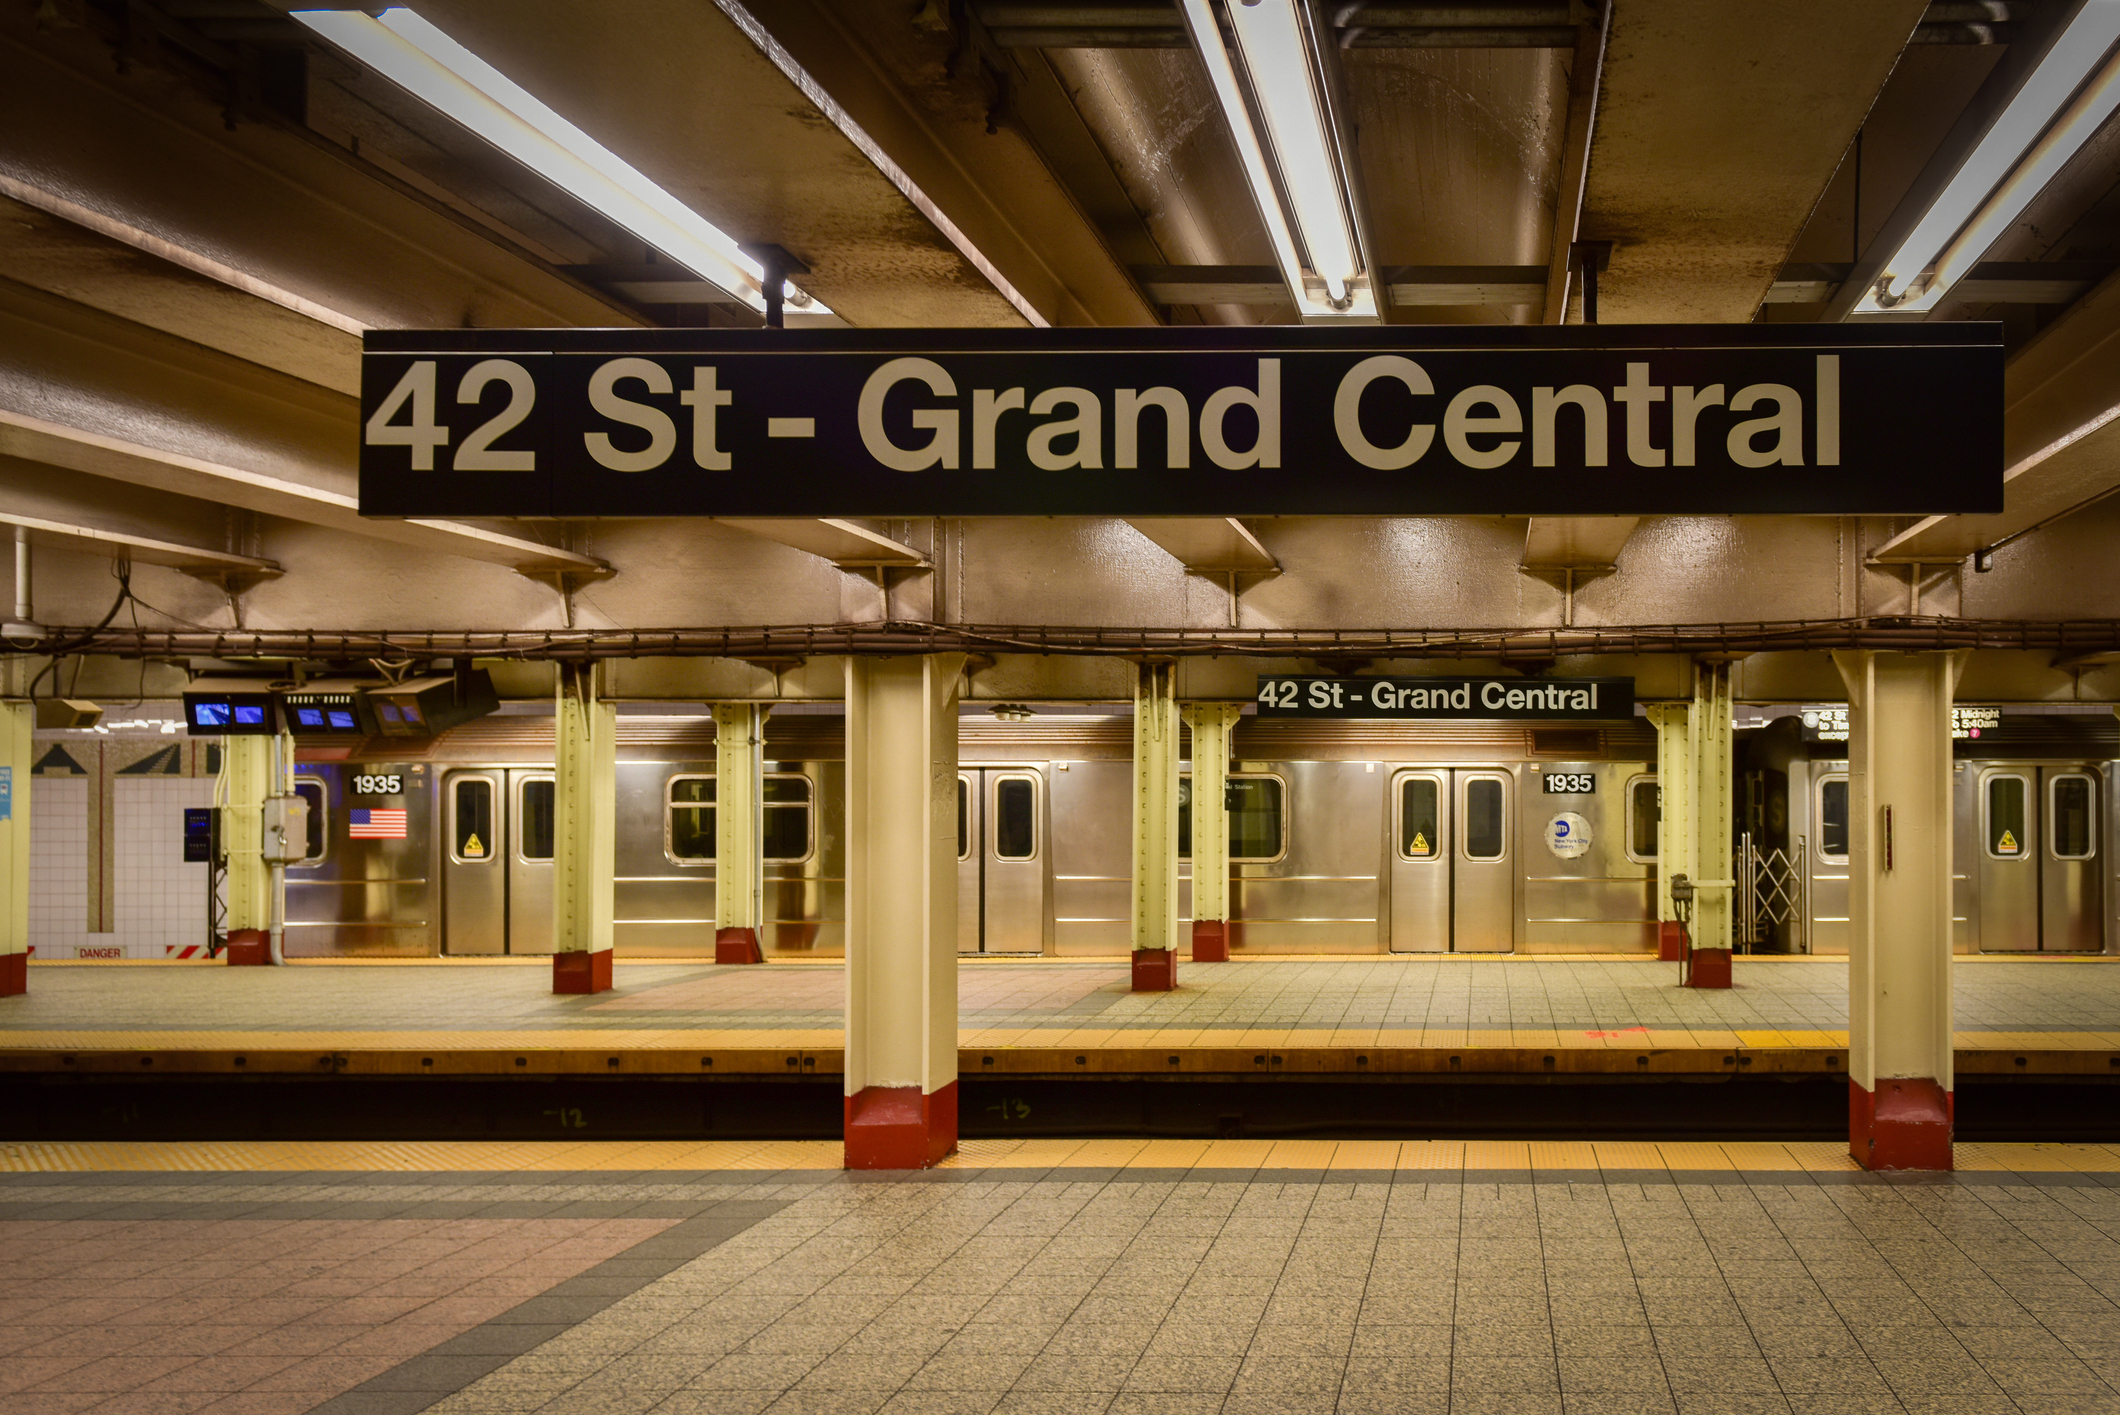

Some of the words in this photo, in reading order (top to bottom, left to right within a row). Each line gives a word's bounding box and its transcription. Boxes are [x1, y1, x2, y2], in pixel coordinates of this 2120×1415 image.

[366, 358, 536, 472] 42
[584, 357, 733, 473] St
[767, 417, 815, 438] -
[857, 356, 1281, 472] Grand
[1333, 354, 1840, 471] Central
[1258, 680, 1299, 709] 42
[1307, 680, 1344, 709] St
[1371, 681, 1470, 710] Grand
[1480, 681, 1598, 710] Central
[1818, 710, 1833, 721] 42
[1834, 710, 1847, 721] St
[1960, 708, 2000, 720] Midnight
[1818, 720, 1831, 731] to
[1961, 718, 1999, 729] 5:40am
[353, 774, 401, 794] 1935
[1546, 774, 1592, 792] 1935
[80, 948, 121, 959] DANGER
